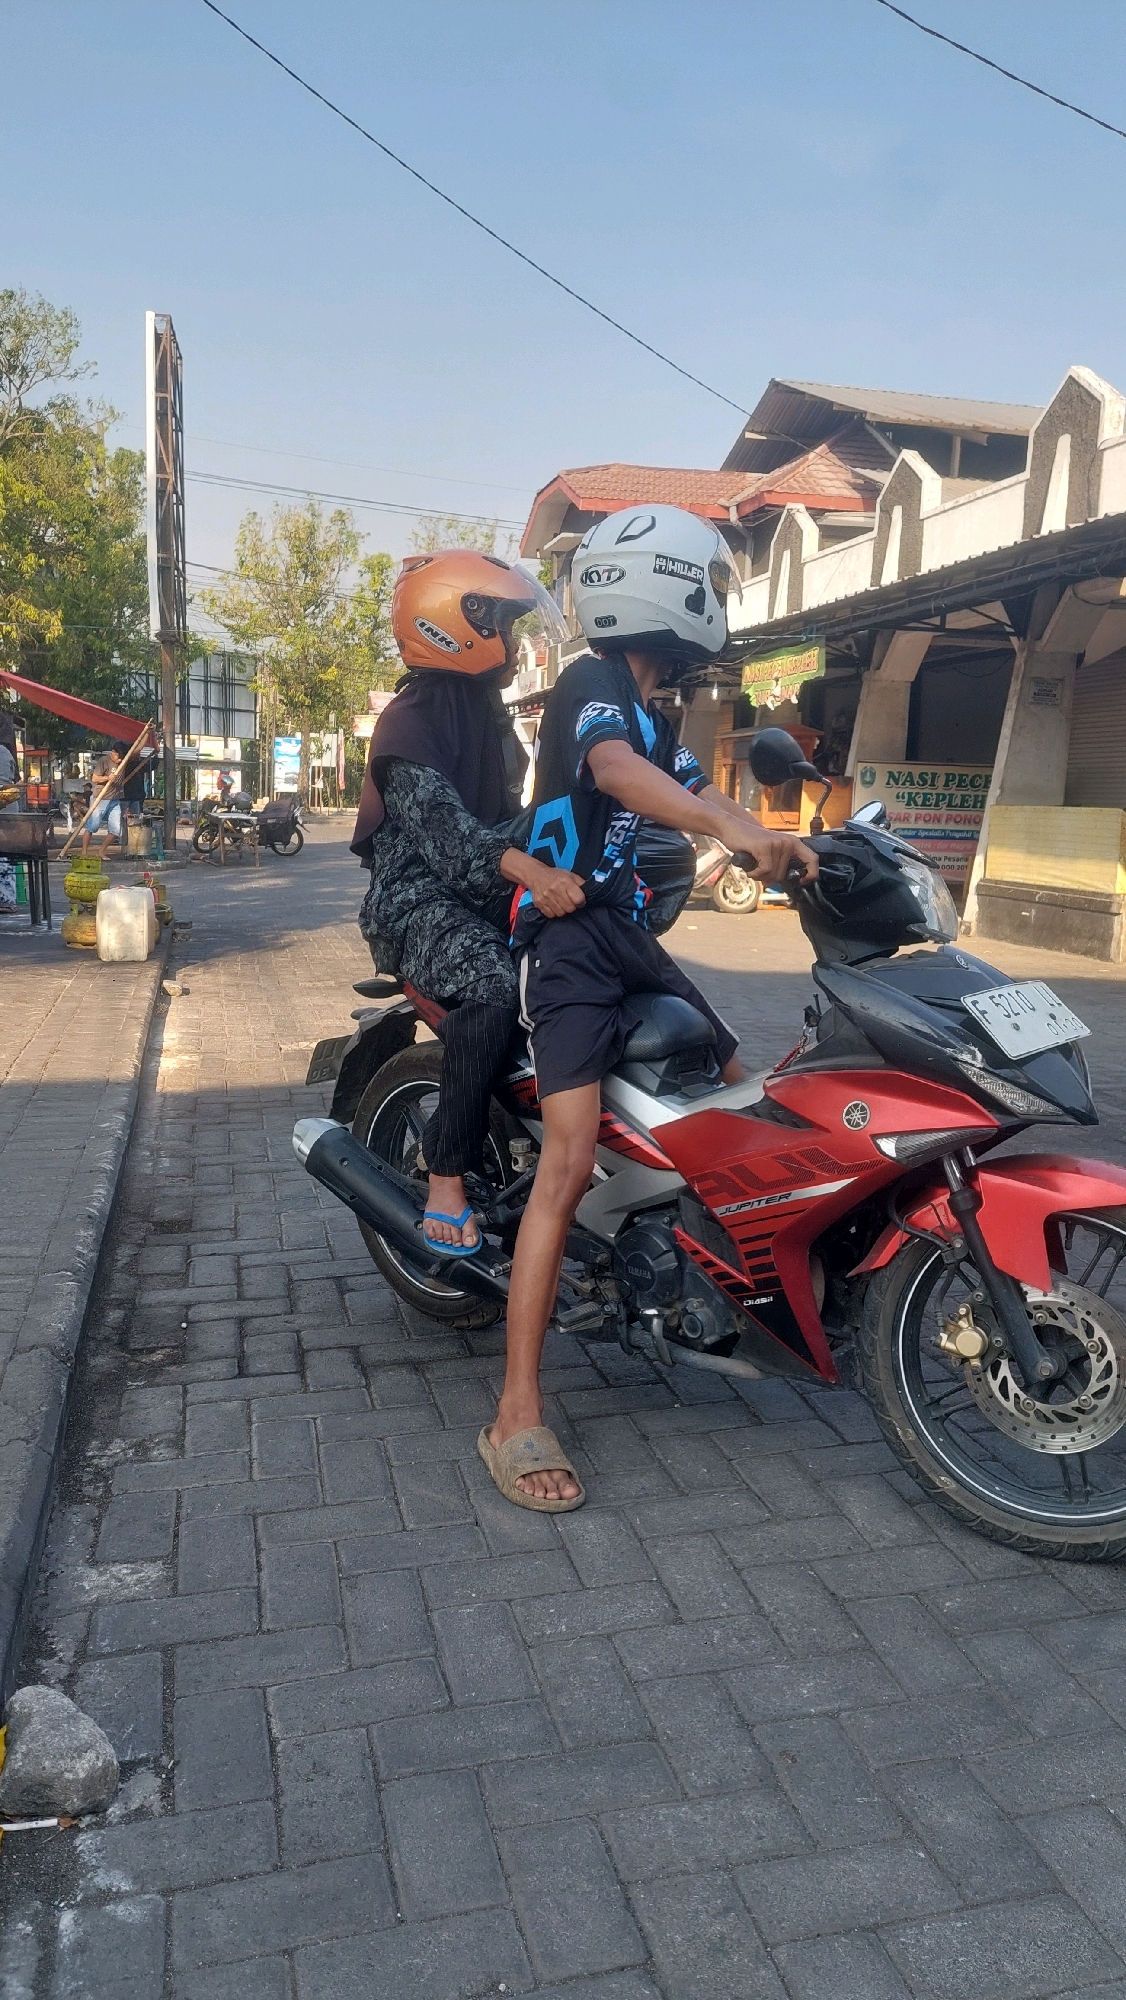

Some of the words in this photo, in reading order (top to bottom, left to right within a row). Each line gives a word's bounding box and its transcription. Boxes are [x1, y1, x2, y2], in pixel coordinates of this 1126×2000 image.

[581, 567, 620, 585] KYT
[668, 560, 704, 583] HILLER
[418, 621, 455, 648] INK
[886, 771, 940, 789] NASI
[943, 772, 992, 790] PECE
[887, 812, 912, 824] SAR
[915, 812, 943, 824] PON
[946, 813, 981, 826] PONO
[970, 999, 992, 1025] F
[988, 989, 1036, 1019] 5210
[719, 1192, 792, 1215] JUPITER
[628, 1265, 652, 1279] YAMAHA
